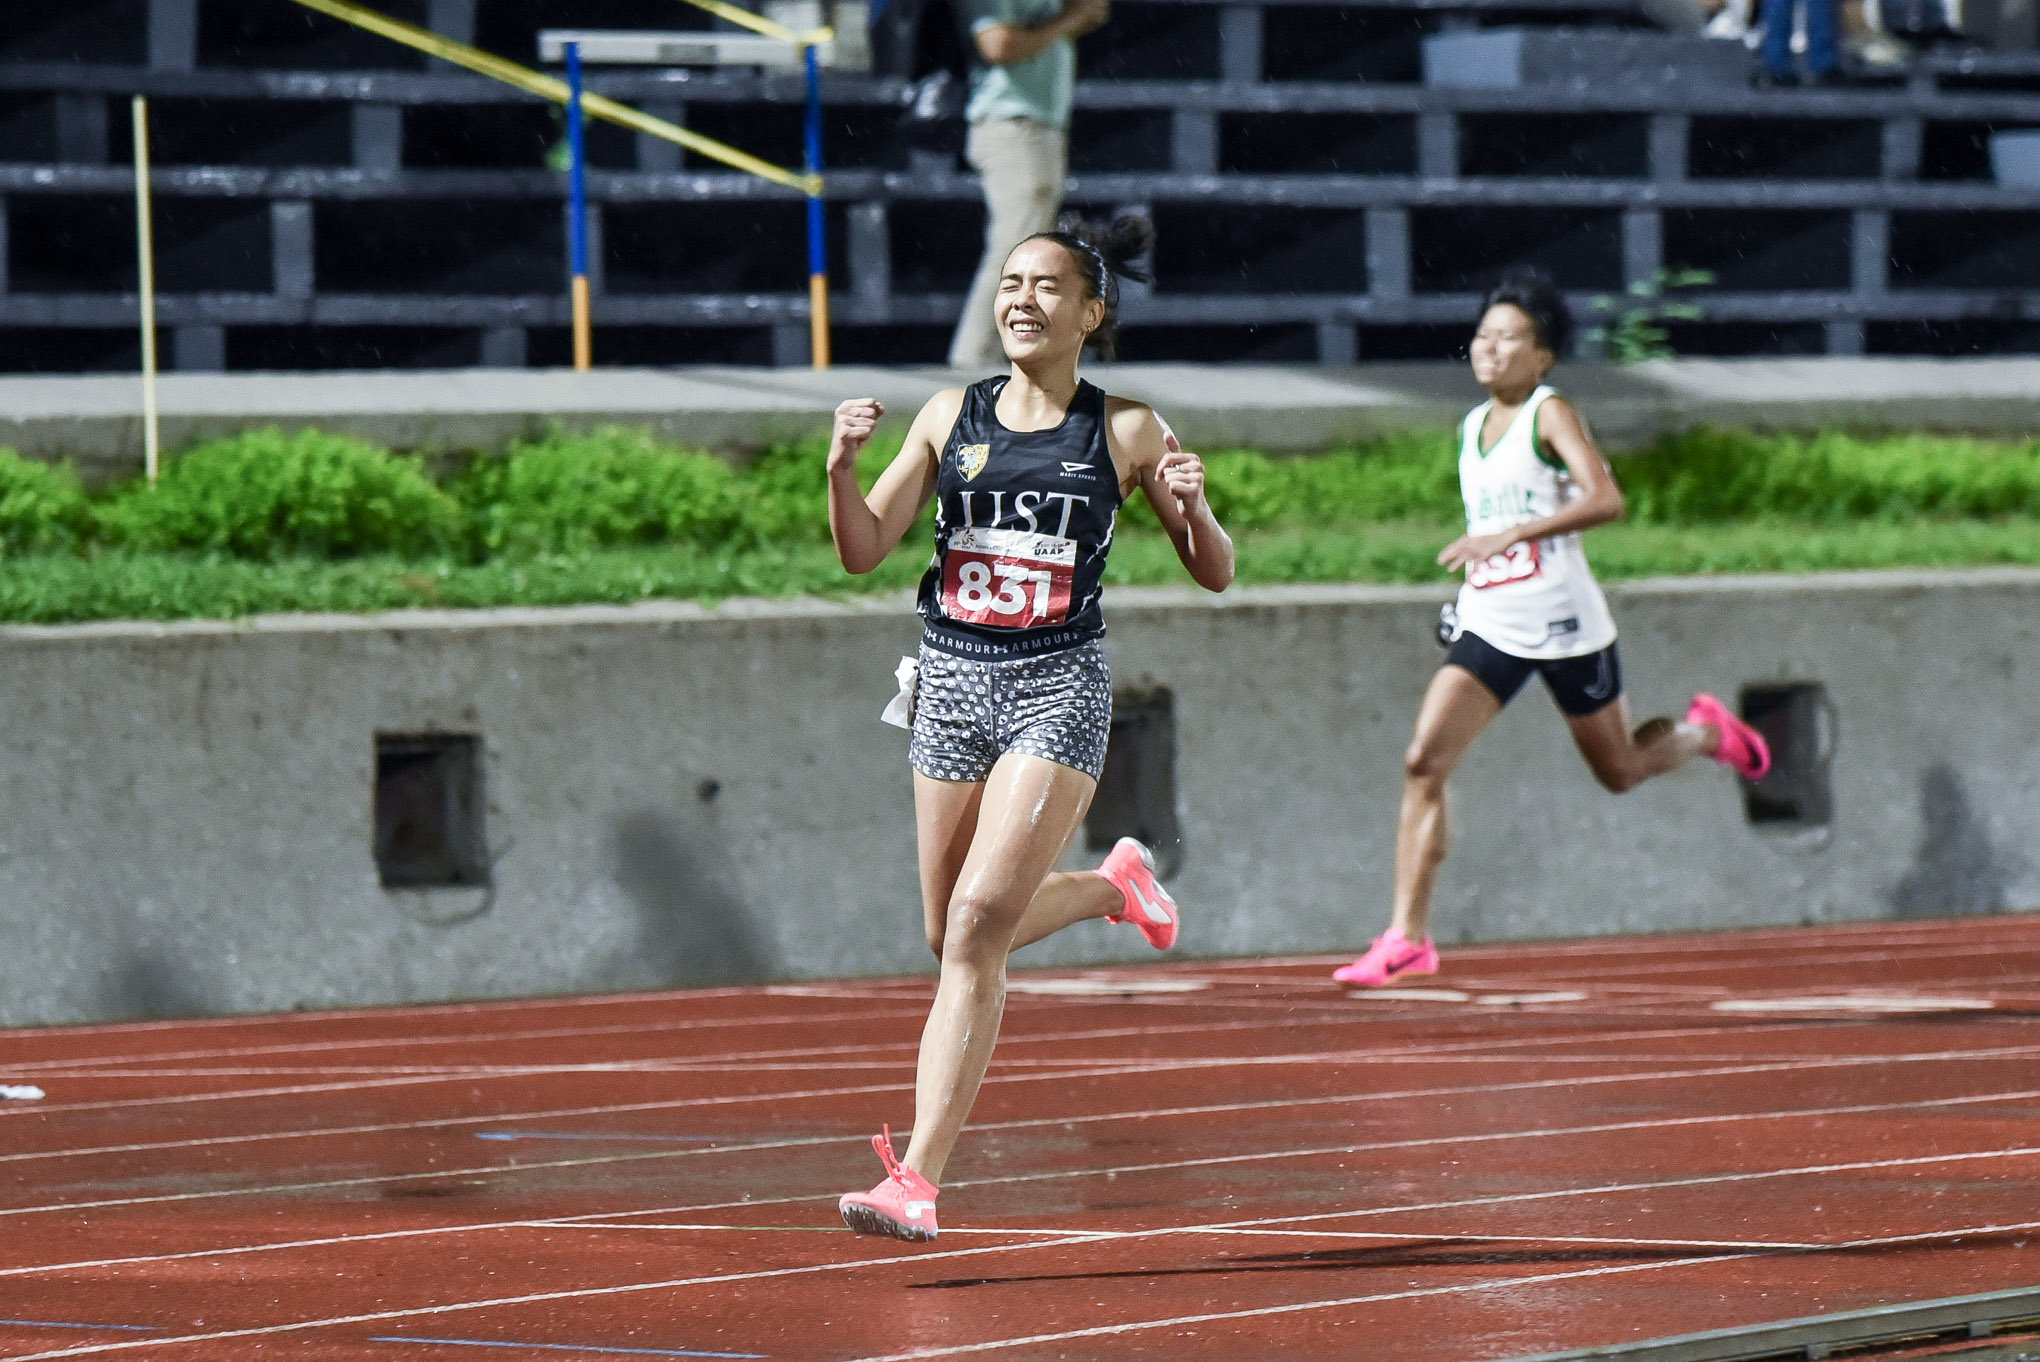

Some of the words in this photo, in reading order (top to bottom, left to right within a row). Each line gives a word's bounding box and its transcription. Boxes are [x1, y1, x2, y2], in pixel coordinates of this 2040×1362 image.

[958, 490, 1090, 540] UST
[938, 635, 991, 654] ARMOUR
[1012, 632, 1071, 652] ARMOUR
